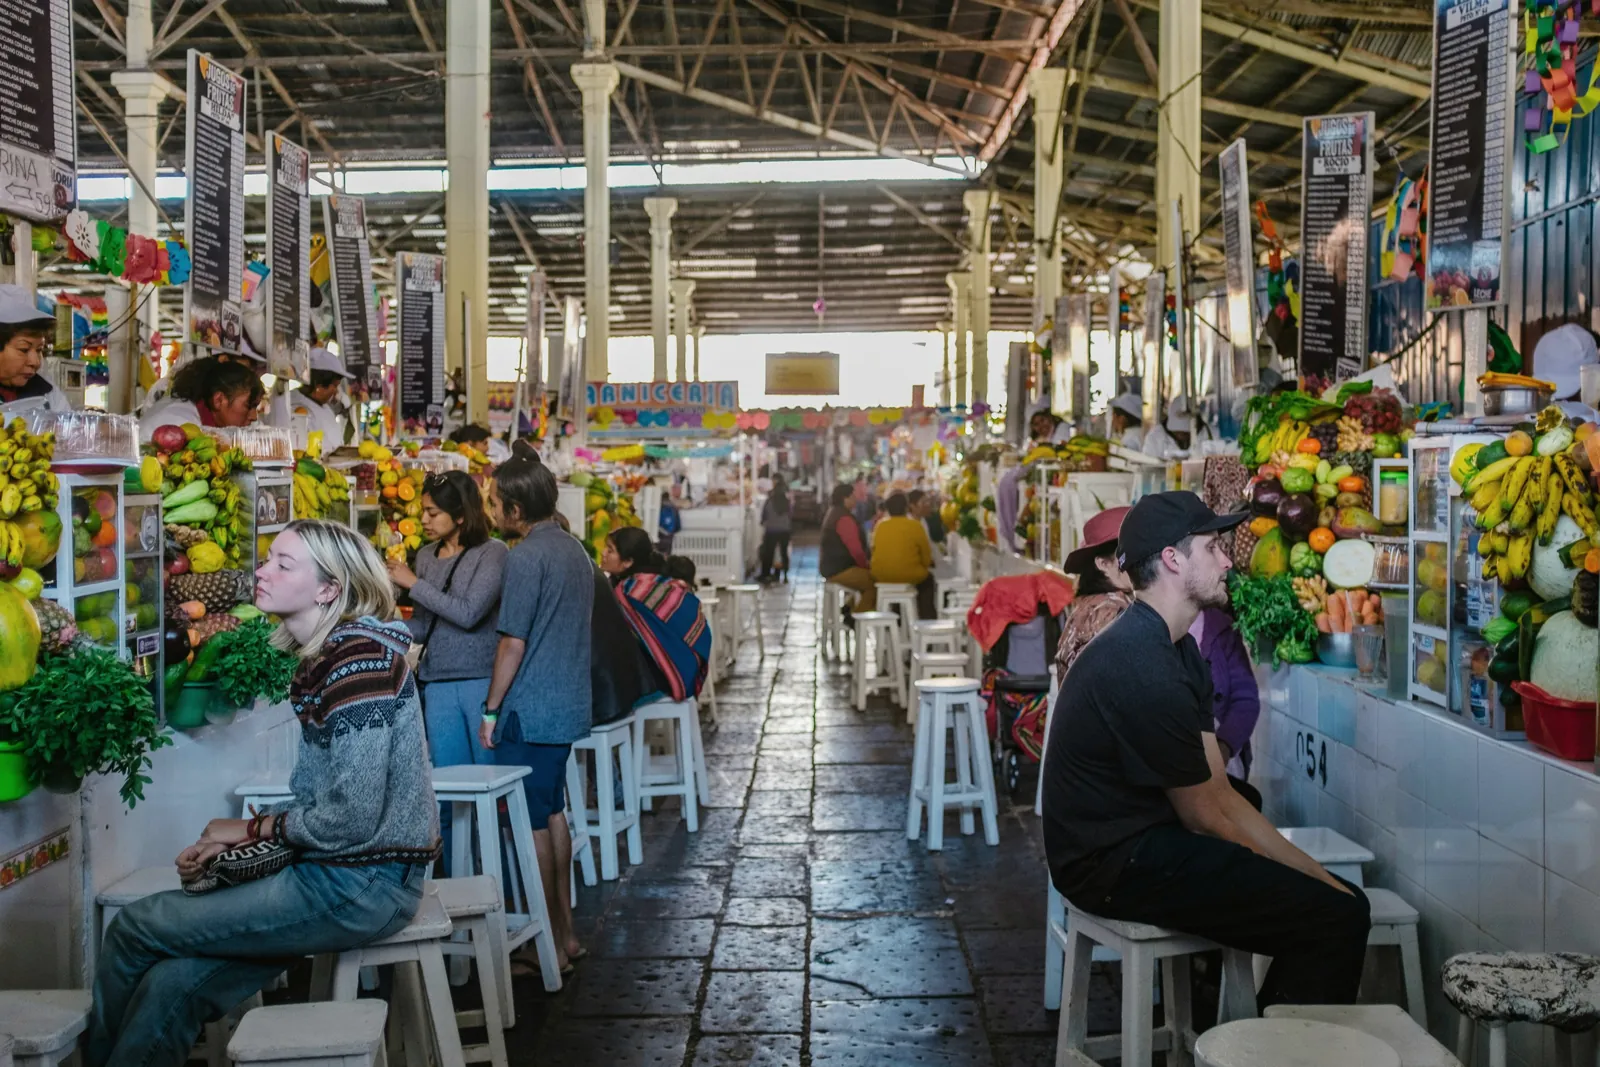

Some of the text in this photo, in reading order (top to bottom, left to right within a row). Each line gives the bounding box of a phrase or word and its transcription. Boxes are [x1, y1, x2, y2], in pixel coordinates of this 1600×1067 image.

[206, 63, 230, 90] JUGOS
[207, 83, 234, 112] FRUTAS
[1320, 138, 1353, 157] FRUTAS
[51, 168, 73, 192] LORIA
[1474, 287, 1493, 298] LECHE
